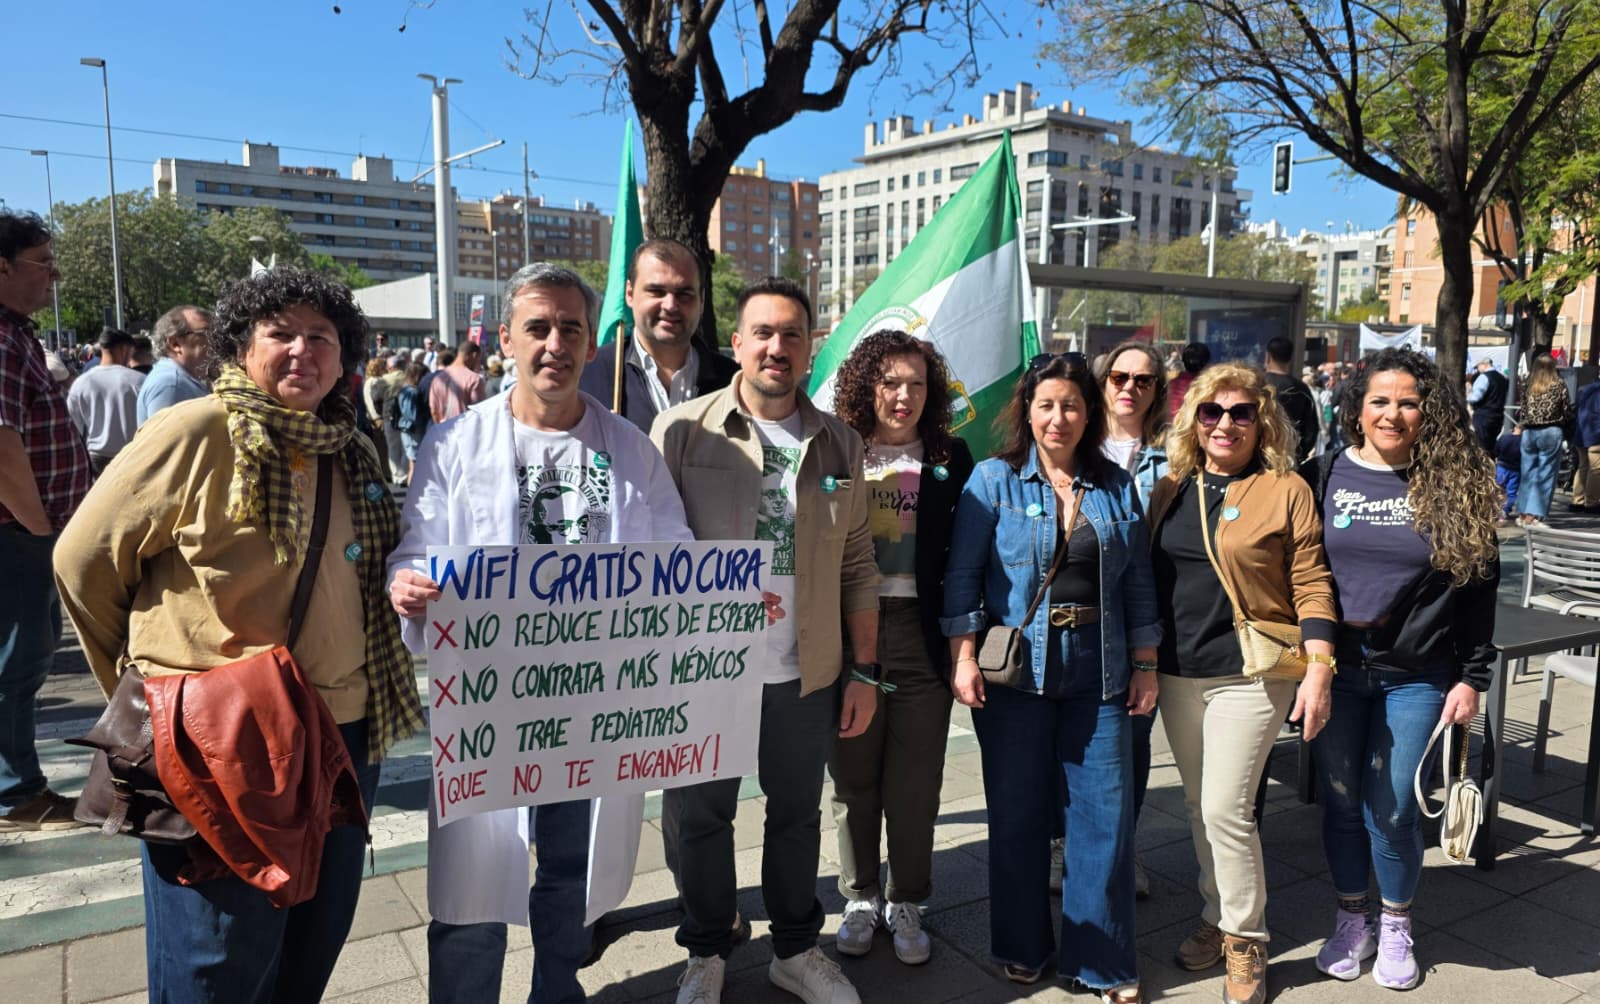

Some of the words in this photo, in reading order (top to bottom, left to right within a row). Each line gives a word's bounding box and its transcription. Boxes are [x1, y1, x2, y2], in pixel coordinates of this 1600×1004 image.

[1333, 488, 1366, 502] San
[430, 547, 519, 601] WIFI
[529, 545, 646, 605] GRATIS
[652, 542, 693, 597] NO
[696, 547, 766, 594] CURA
[464, 610, 500, 650] NO
[514, 610, 602, 647] REDUCE
[609, 600, 672, 640] LISTAS
[675, 602, 704, 637] DE
[707, 600, 767, 633] ESPERA
[461, 664, 498, 705] NO
[512, 661, 605, 699] CONTRATA
[616, 649, 661, 690] MÁS
[670, 644, 750, 686] MÉDICOS
[459, 720, 495, 762] NO
[516, 717, 572, 752] TRAE
[590, 701, 690, 743] PEDIATRAS
[513, 764, 542, 796] NO
[565, 759, 594, 789] TE
[617, 733, 721, 781] ENGAÑEN!
